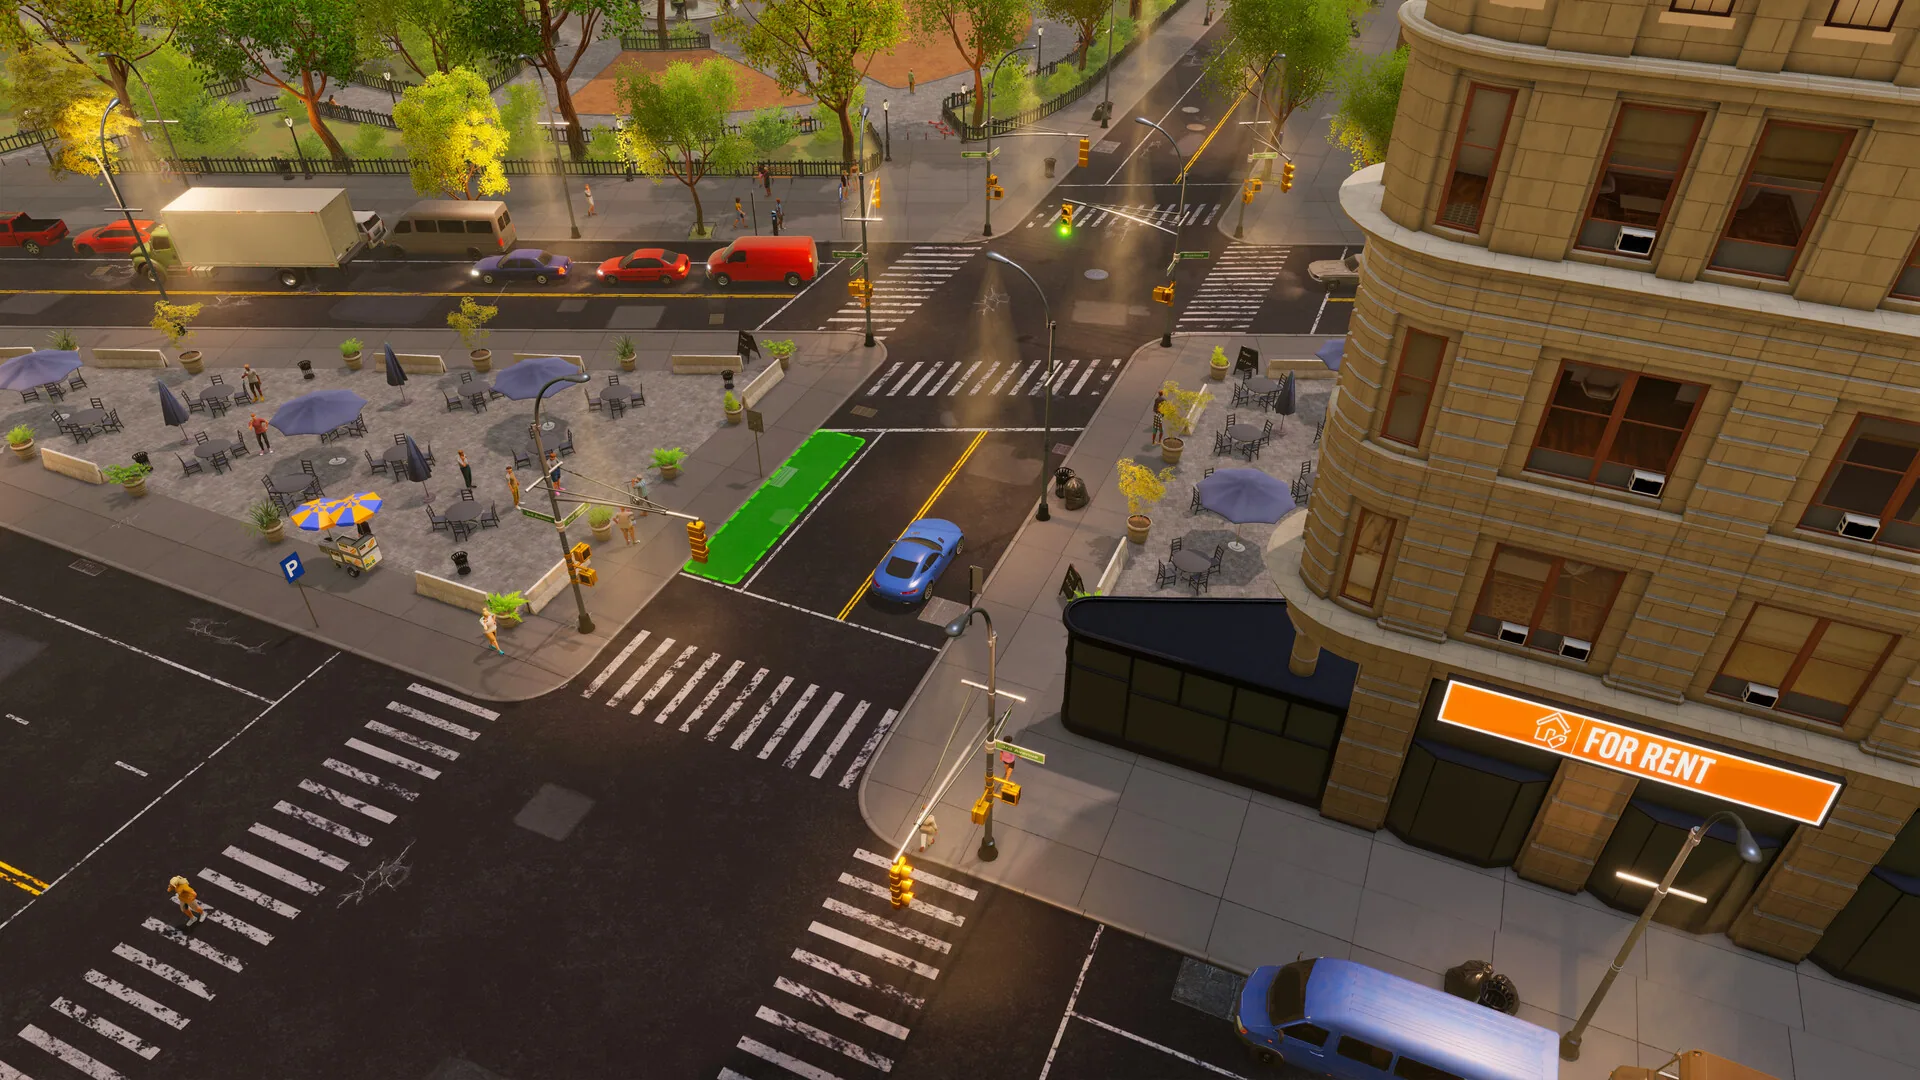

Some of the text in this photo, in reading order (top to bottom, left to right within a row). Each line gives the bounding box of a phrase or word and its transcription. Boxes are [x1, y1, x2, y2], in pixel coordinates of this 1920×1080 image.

[285, 559, 298, 578] P
[1014, 748, 1039, 759] Avenue
[1583, 726, 1717, 784] FOR RENT
